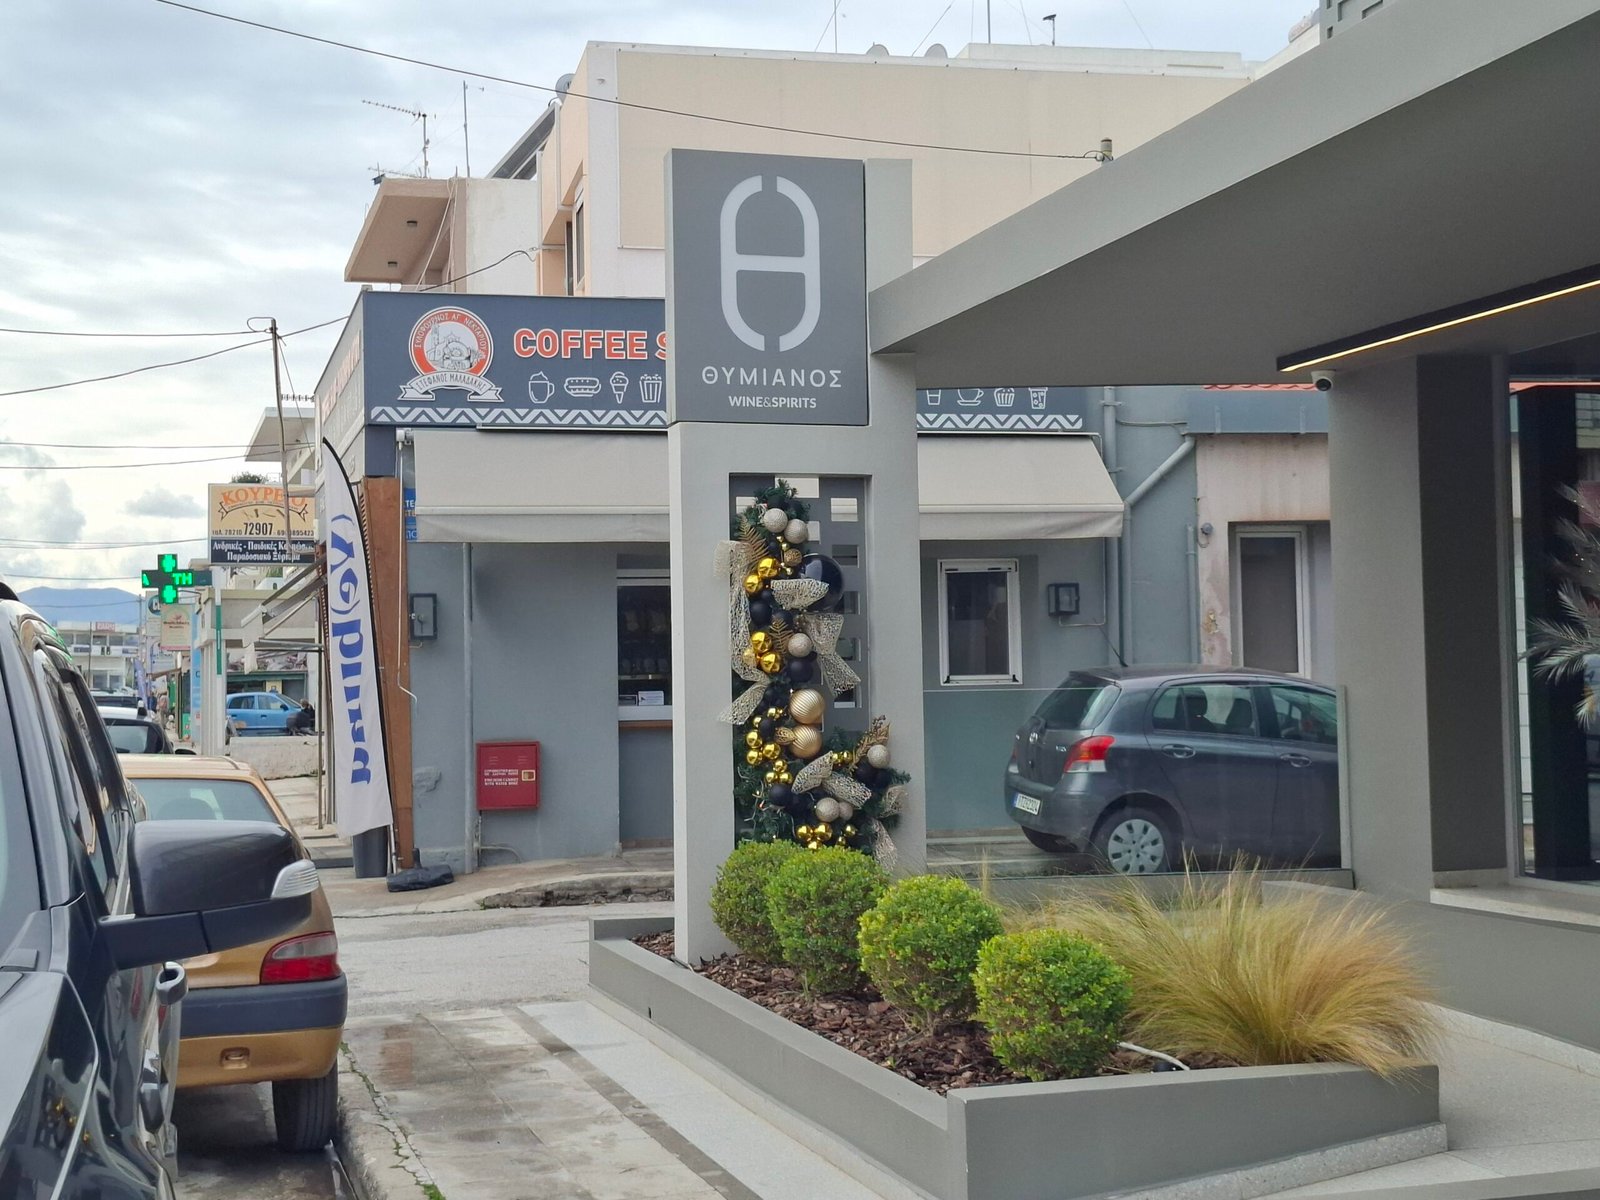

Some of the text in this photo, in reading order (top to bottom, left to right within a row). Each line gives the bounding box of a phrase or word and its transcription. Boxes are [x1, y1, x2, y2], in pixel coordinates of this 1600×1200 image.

[513, 328, 648, 360] COFFEE
[701, 365, 842, 388] ΘΥΜΙΑΝΟΣ
[728, 395, 817, 409] WINE&SPIRITS
[221, 486, 306, 507] ΚΟΥΡΕΟ
[243, 522, 273, 536] 72907
